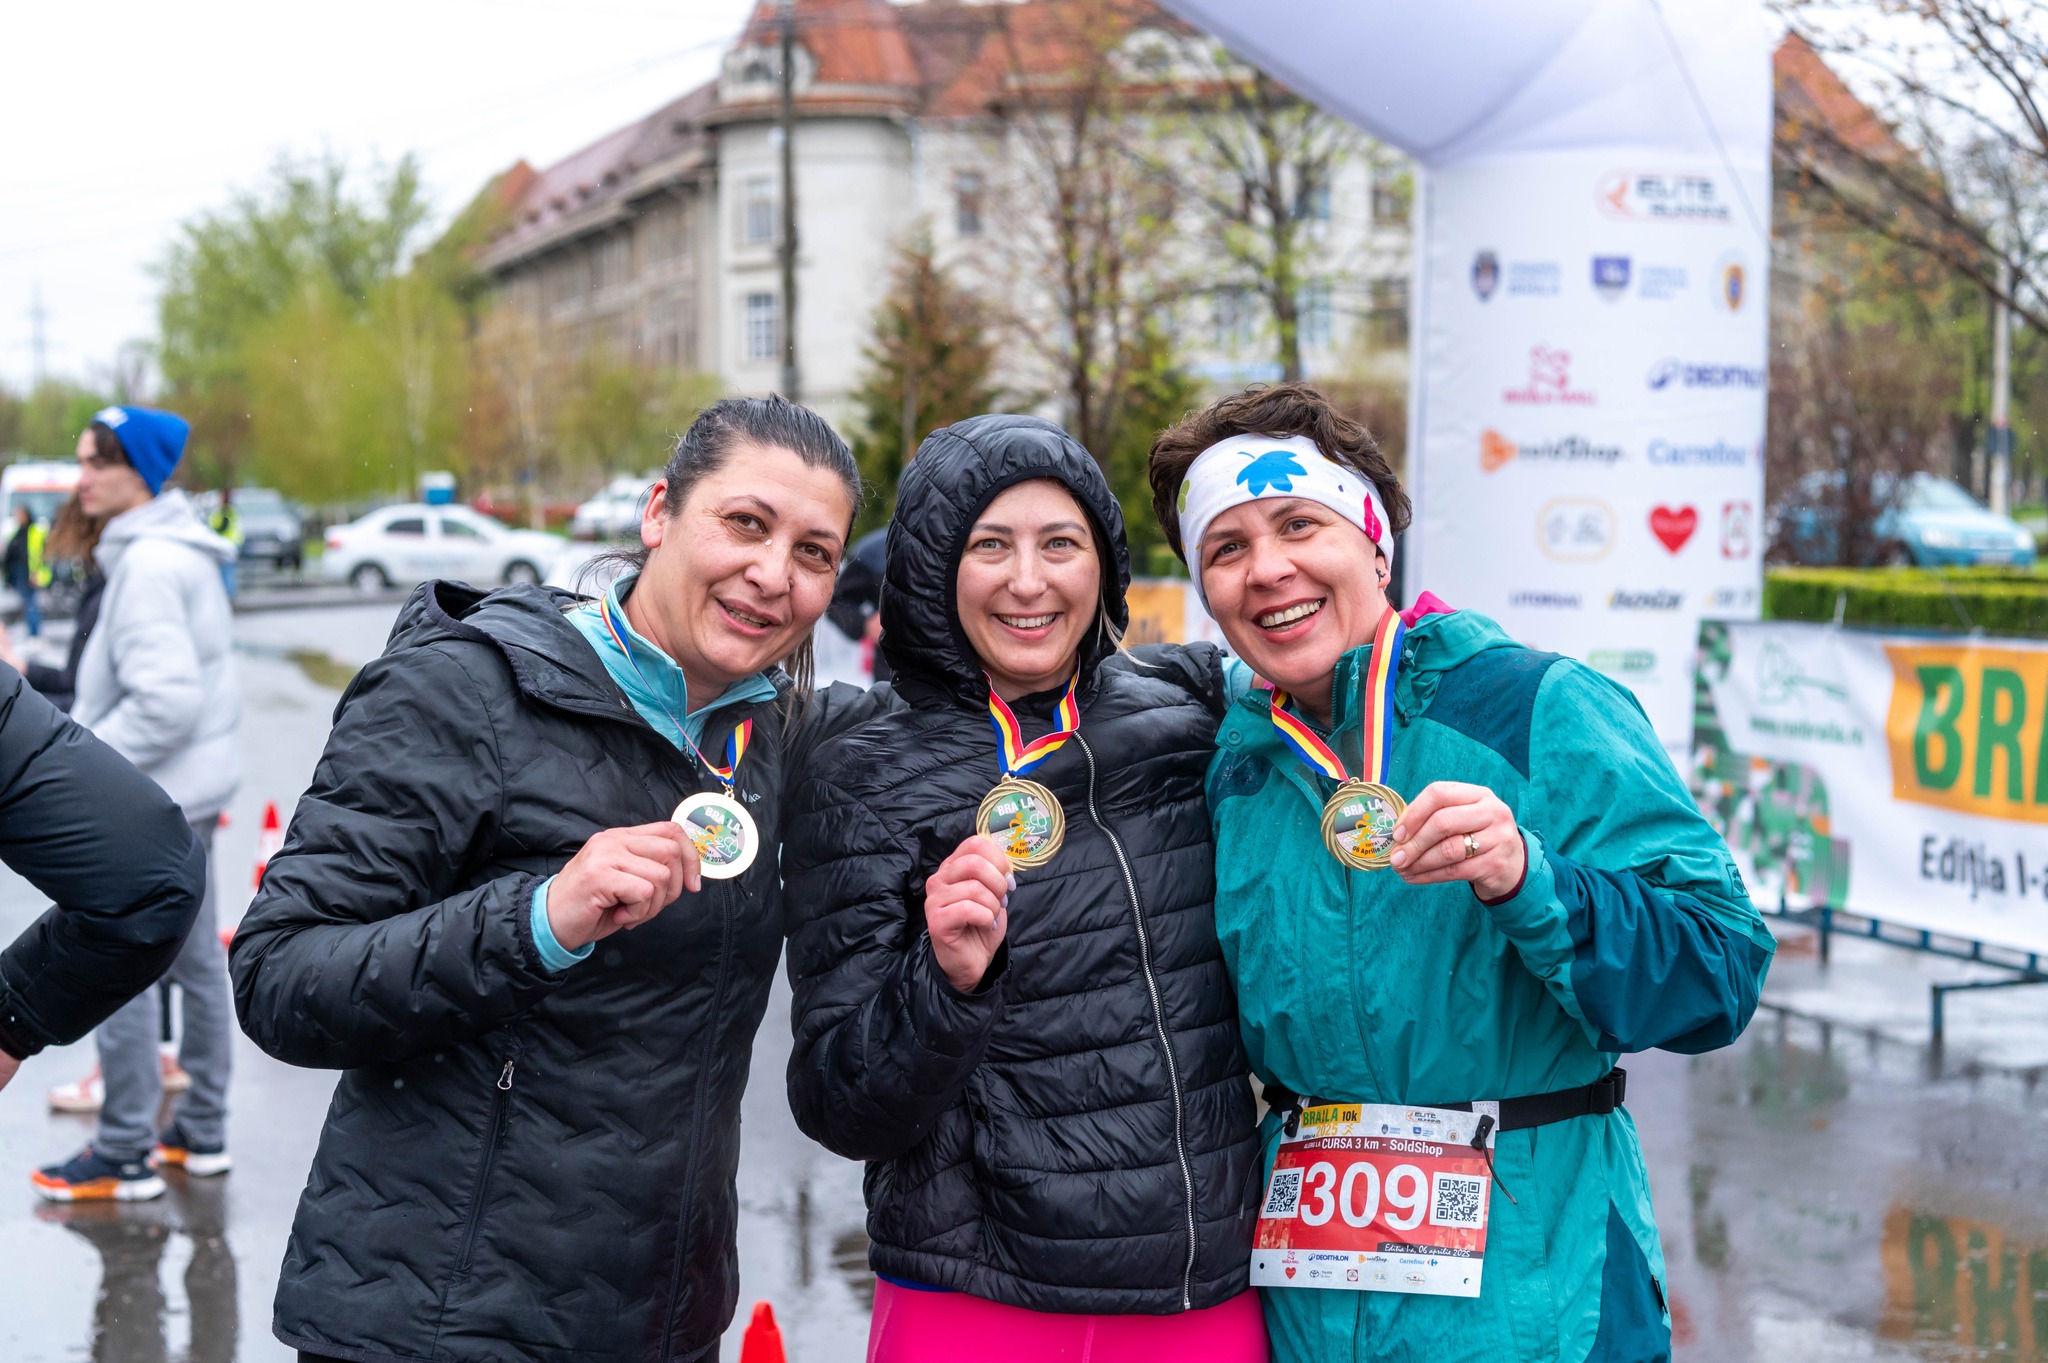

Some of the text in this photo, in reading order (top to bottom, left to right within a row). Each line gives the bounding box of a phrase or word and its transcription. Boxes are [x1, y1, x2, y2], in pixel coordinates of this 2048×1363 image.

[1342, 1110, 1358, 1122] 10k
[1414, 1111, 1436, 1119] ELITE
[1315, 1122, 1339, 1138] 2025
[1321, 1137, 1353, 1150] CURSA
[1354, 1137, 1362, 1150] 3
[1363, 1137, 1380, 1150] km
[1389, 1139, 1443, 1158] SoldShop
[1301, 1161, 1429, 1231] 309
[1418, 1245, 1428, 1254] 06
[1428, 1246, 1452, 1256] aprilie
[1452, 1248, 1471, 1258] 2025
